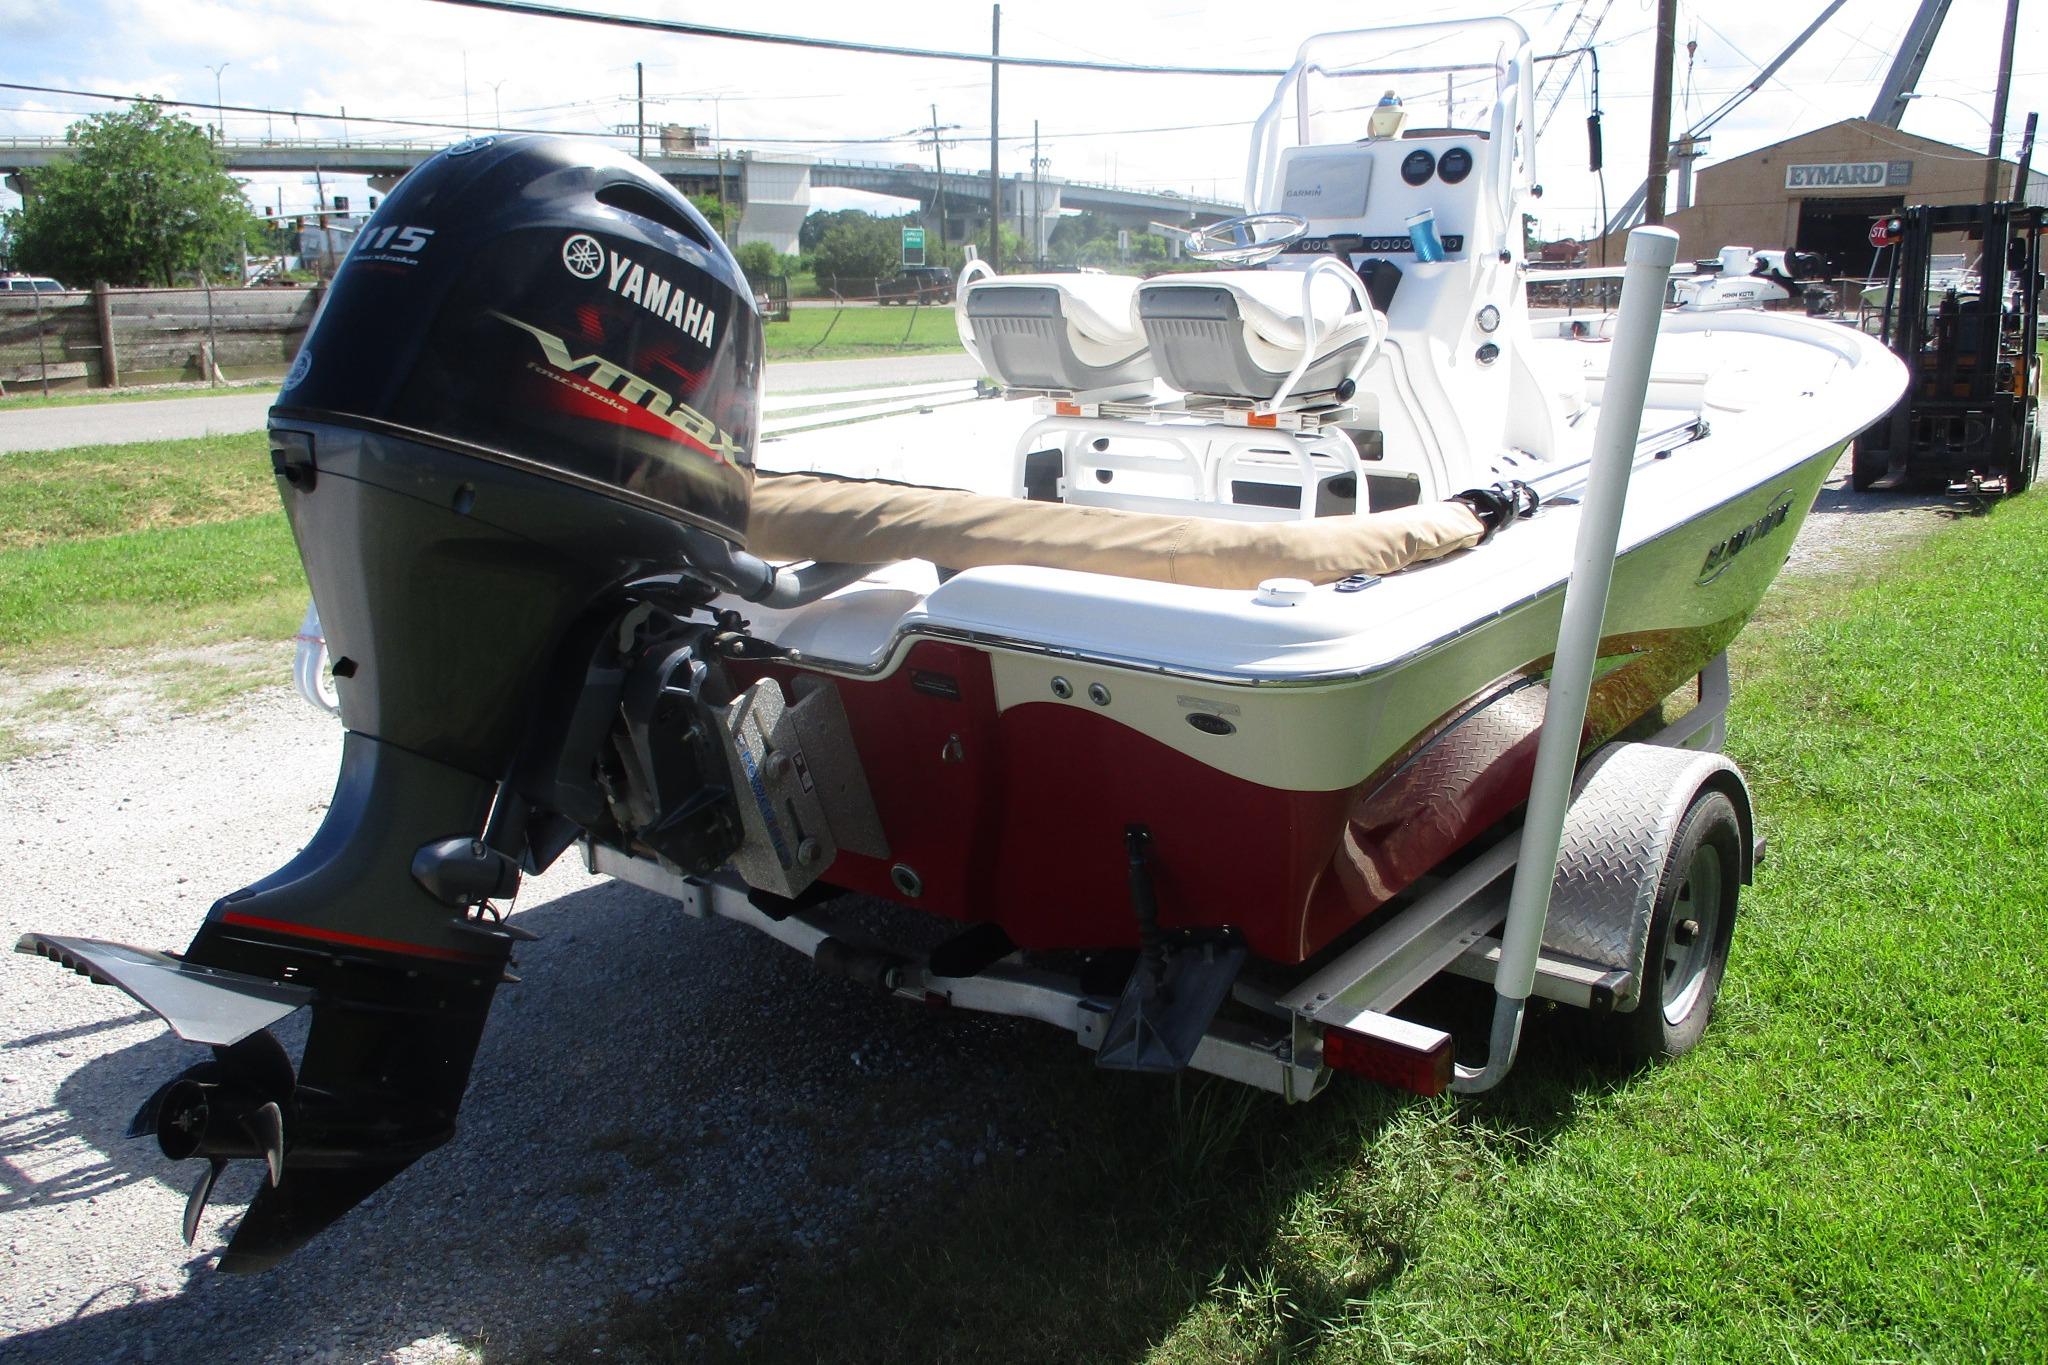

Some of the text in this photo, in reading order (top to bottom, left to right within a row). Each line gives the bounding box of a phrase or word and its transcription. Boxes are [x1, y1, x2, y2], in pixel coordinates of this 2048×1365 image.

[1788, 165, 1884, 186] EYMARD
[1286, 189, 1320, 197] GARMIN
[359, 225, 435, 253] 115
[1870, 227, 1887, 238] STO
[607, 250, 715, 349] YAMAHA
